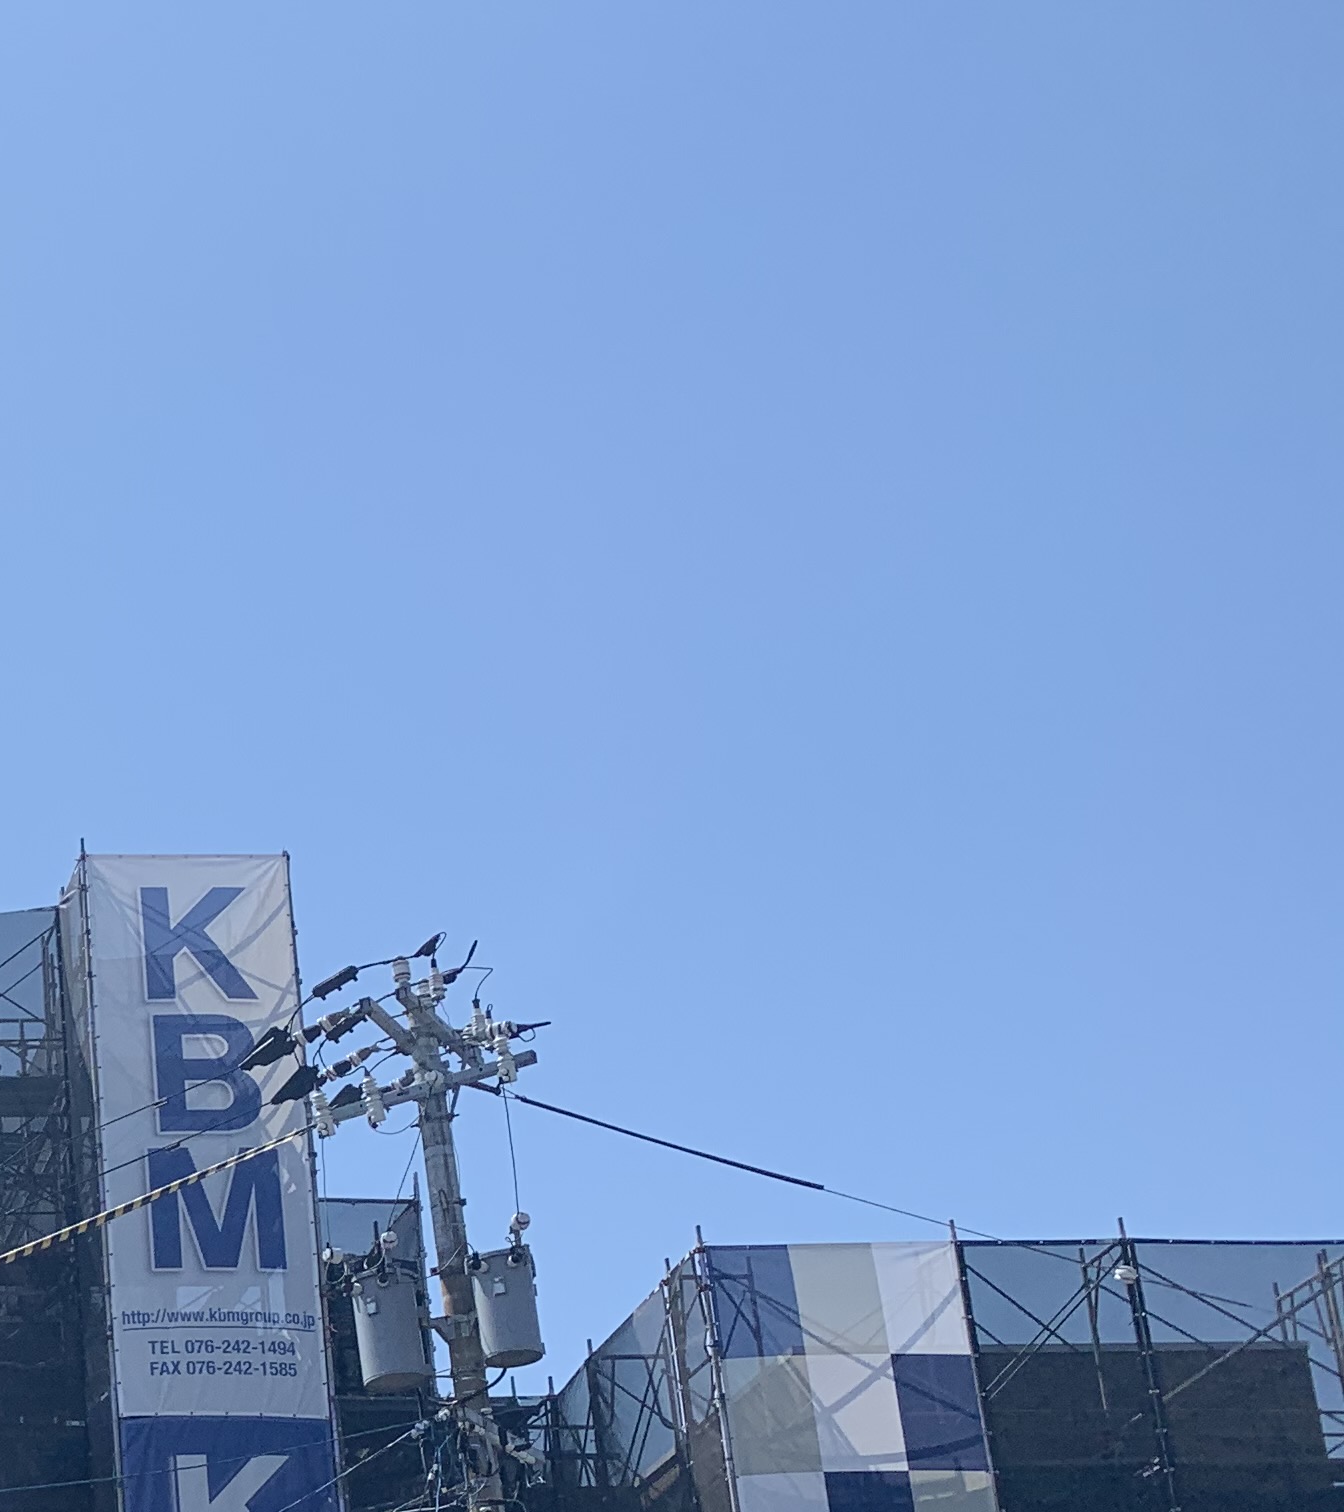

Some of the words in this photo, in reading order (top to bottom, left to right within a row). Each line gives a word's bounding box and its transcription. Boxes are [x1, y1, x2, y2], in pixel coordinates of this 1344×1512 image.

[138, 885, 288, 1273] KBM
[121, 1308, 316, 1329] http://www.kbmgroup.co.jp
[148, 1340, 180, 1355] TEL
[184, 1340, 296, 1356] 076-242-1494
[150, 1361, 181, 1376] FAX
[186, 1361, 298, 1377] 076-242-1585
